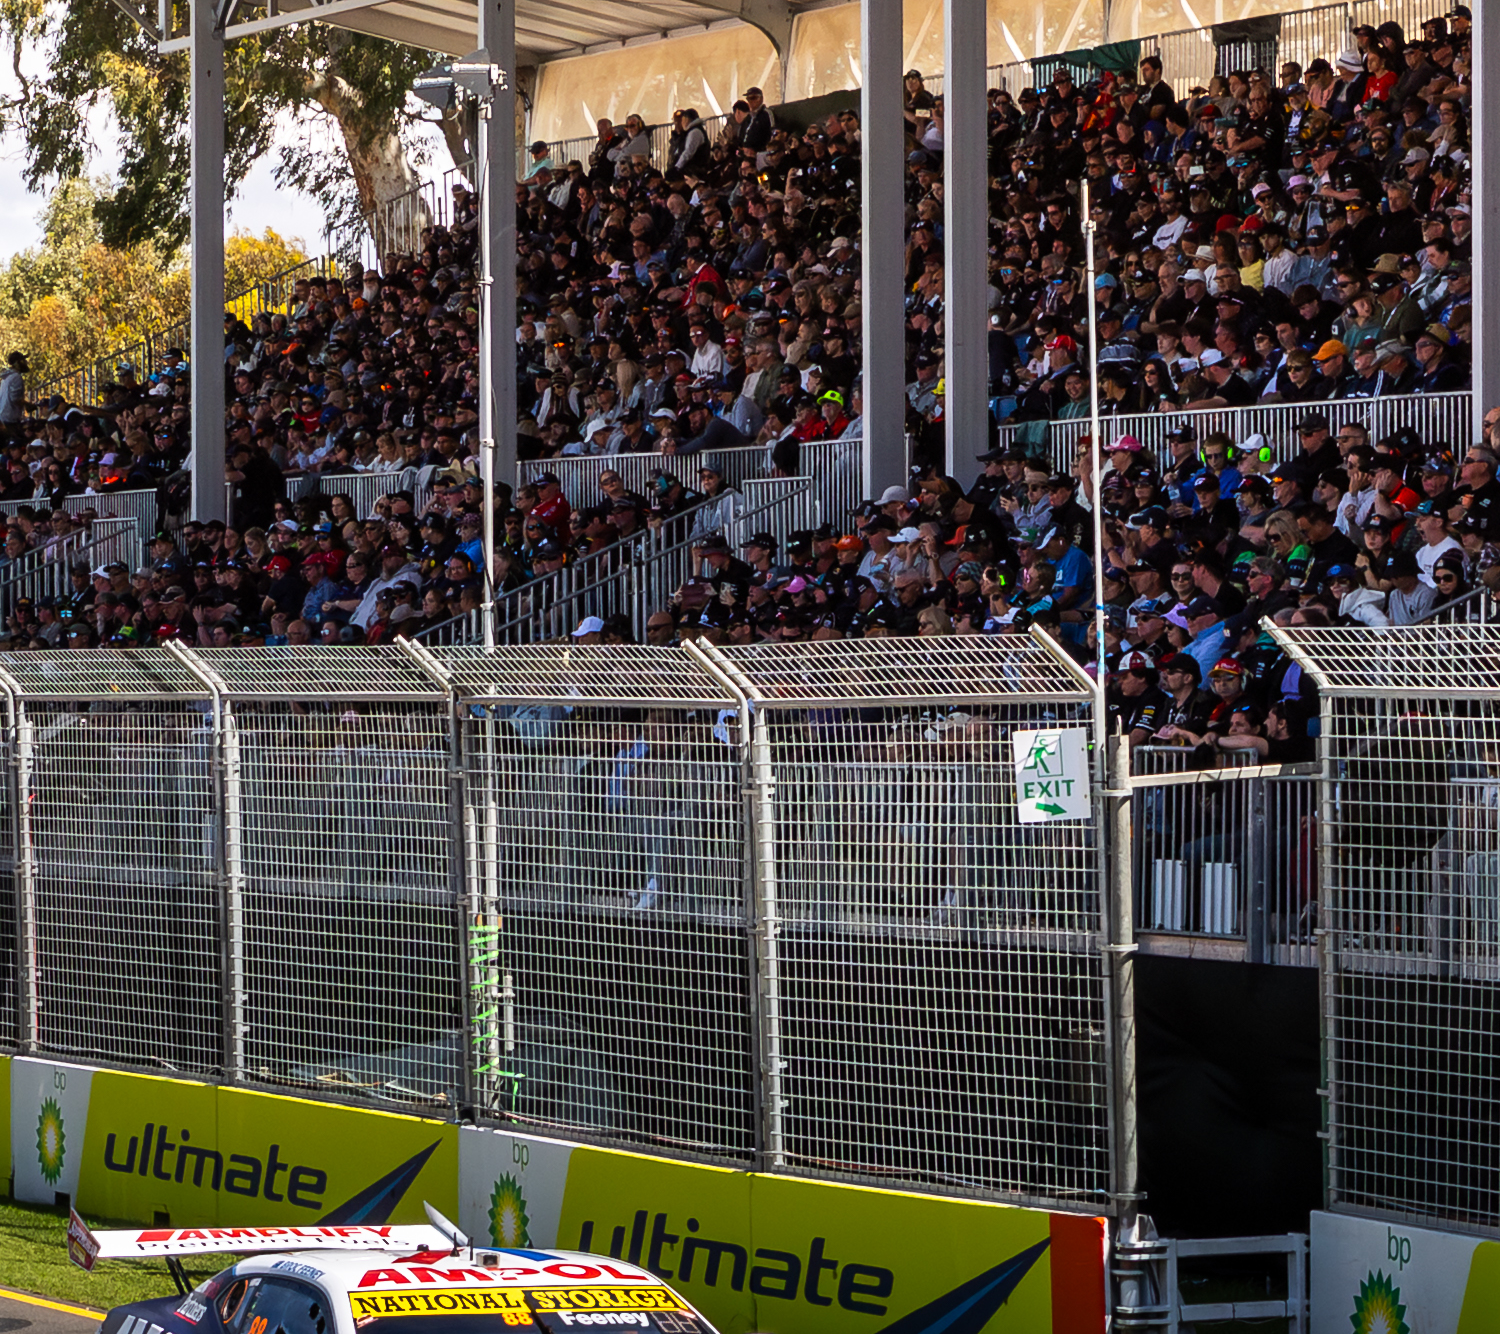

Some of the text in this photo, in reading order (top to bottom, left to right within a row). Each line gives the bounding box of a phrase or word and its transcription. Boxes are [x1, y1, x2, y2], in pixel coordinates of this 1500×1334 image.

[1024, 779, 1075, 799] EXIT
[53, 1070, 65, 1094] bp
[104, 1123, 327, 1209] ultimate
[511, 1138, 529, 1172] bp
[177, 1226, 393, 1240] AMPLIFY
[1386, 1226, 1411, 1269] bp
[299, 1264, 326, 1280] FEENEY
[357, 1264, 650, 1287] AMPOL
[580, 1211, 893, 1316] ultimate
[358, 1288, 675, 1315] NATIONAL STORAGE
[502, 1310, 649, 1328] 88 Feeney
